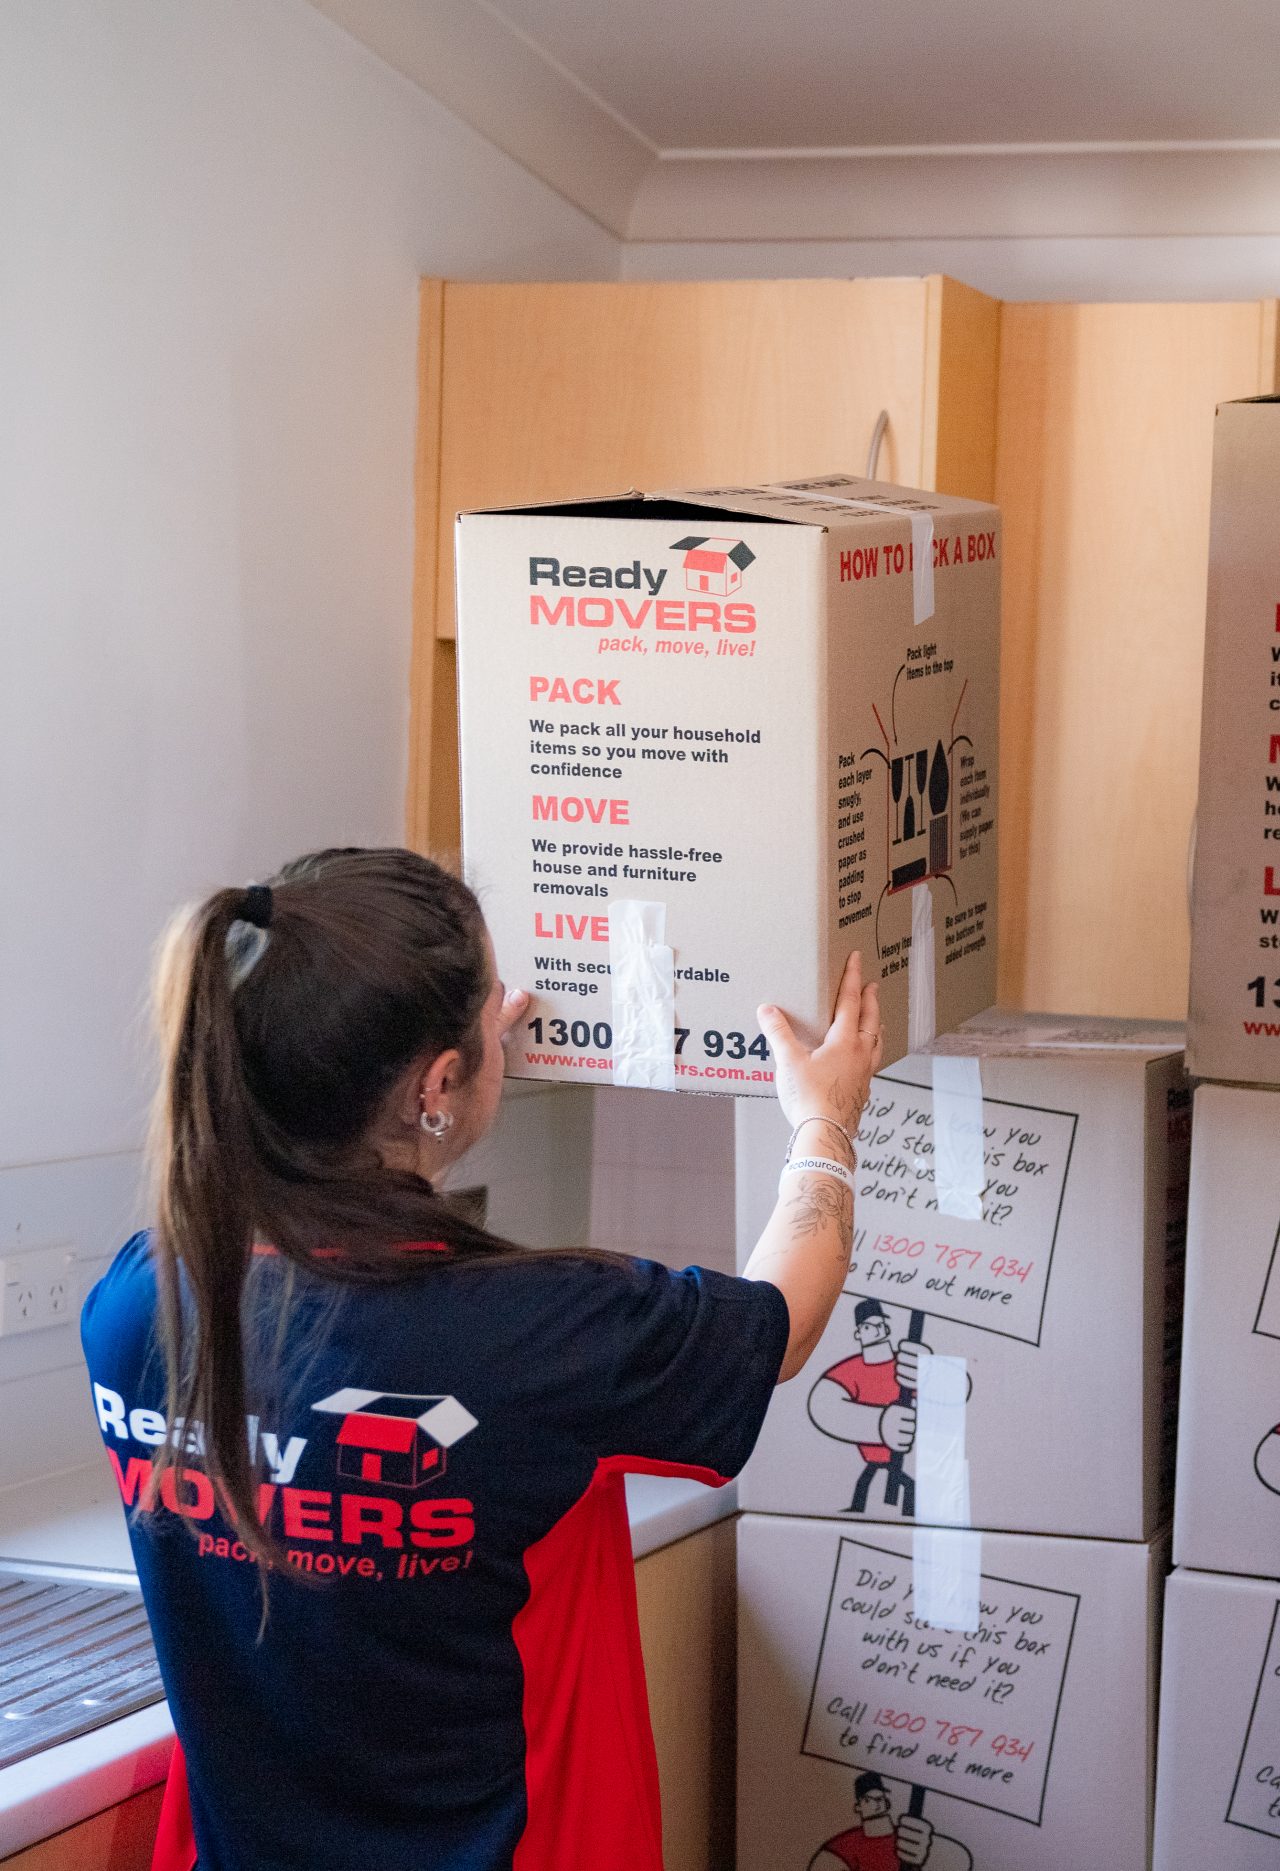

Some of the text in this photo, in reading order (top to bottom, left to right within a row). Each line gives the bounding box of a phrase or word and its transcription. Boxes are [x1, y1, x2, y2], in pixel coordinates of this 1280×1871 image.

[841, 546, 878, 582] HOW
[884, 543, 903, 575] TO
[953, 537, 963, 564] A
[968, 532, 995, 562] BOX
[529, 557, 667, 596] Ready
[530, 595, 757, 634] MOVERS
[598, 636, 756, 657] pack, move, live!
[907, 643, 937, 661] Pack light
[907, 659, 953, 680] items to the top
[530, 677, 622, 705] PACK
[530, 720, 761, 744] We pack all your household
[530, 741, 729, 763] items so you move with
[531, 762, 623, 779] confidence
[532, 795, 630, 825] MOVE
[532, 840, 723, 863] We provide hassle-free
[533, 860, 697, 882] house and furniture
[533, 880, 609, 897] removals
[535, 912, 609, 942] LIVE
[534, 958, 574, 974] With
[674, 967, 730, 983] rdable
[535, 977, 598, 994] storage
[528, 1017, 612, 1049] 1300
[704, 1030, 770, 1061] 934
[873, 1234, 1034, 1283] 1300 787 934
[867, 1260, 1012, 1305] find out more
[286, 1549, 383, 1581] move,
[396, 1550, 473, 1579] live!
[861, 1655, 1015, 1704] don't need it?
[827, 1697, 1034, 1762] Call 1300 787 934
